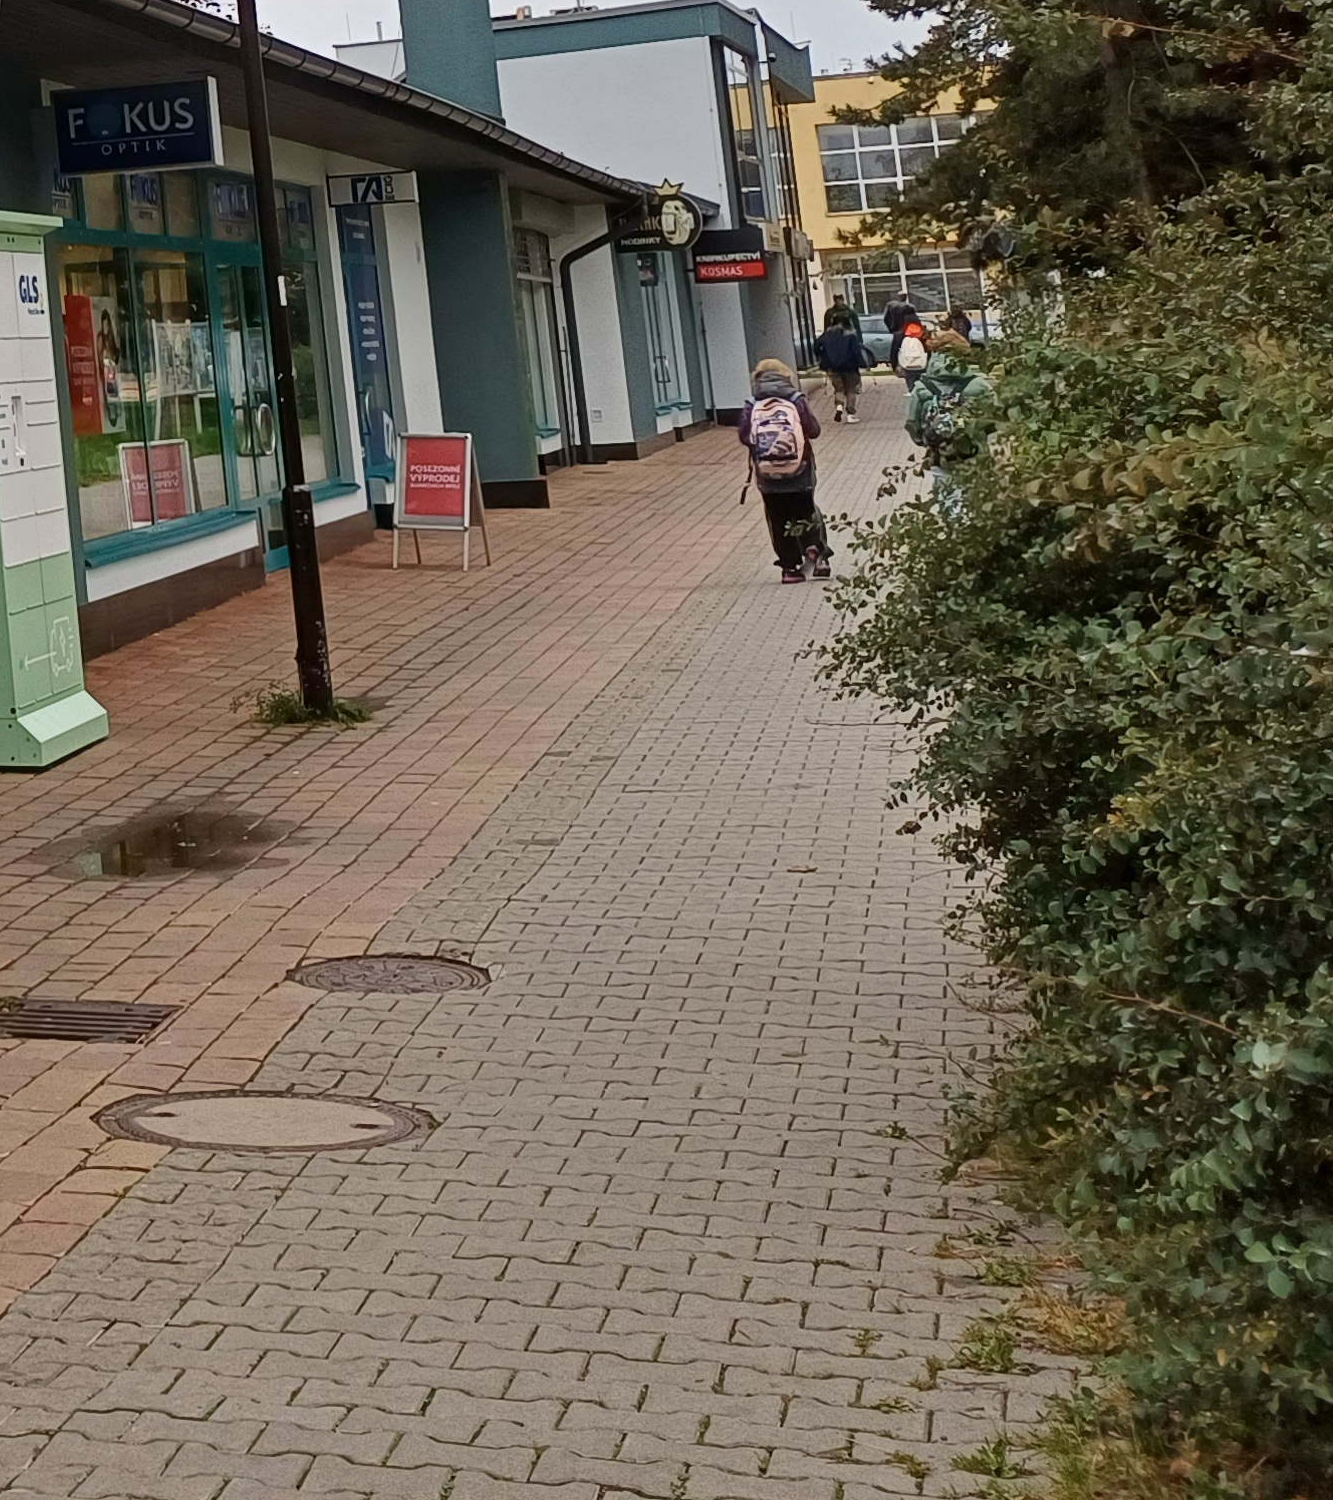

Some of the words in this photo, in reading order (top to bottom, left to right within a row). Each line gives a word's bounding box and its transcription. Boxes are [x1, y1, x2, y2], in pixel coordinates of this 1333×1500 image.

[101, 139, 167, 156] OPTIK
[700, 265, 744, 278] KOSMAS
[19, 275, 39, 304] GLS
